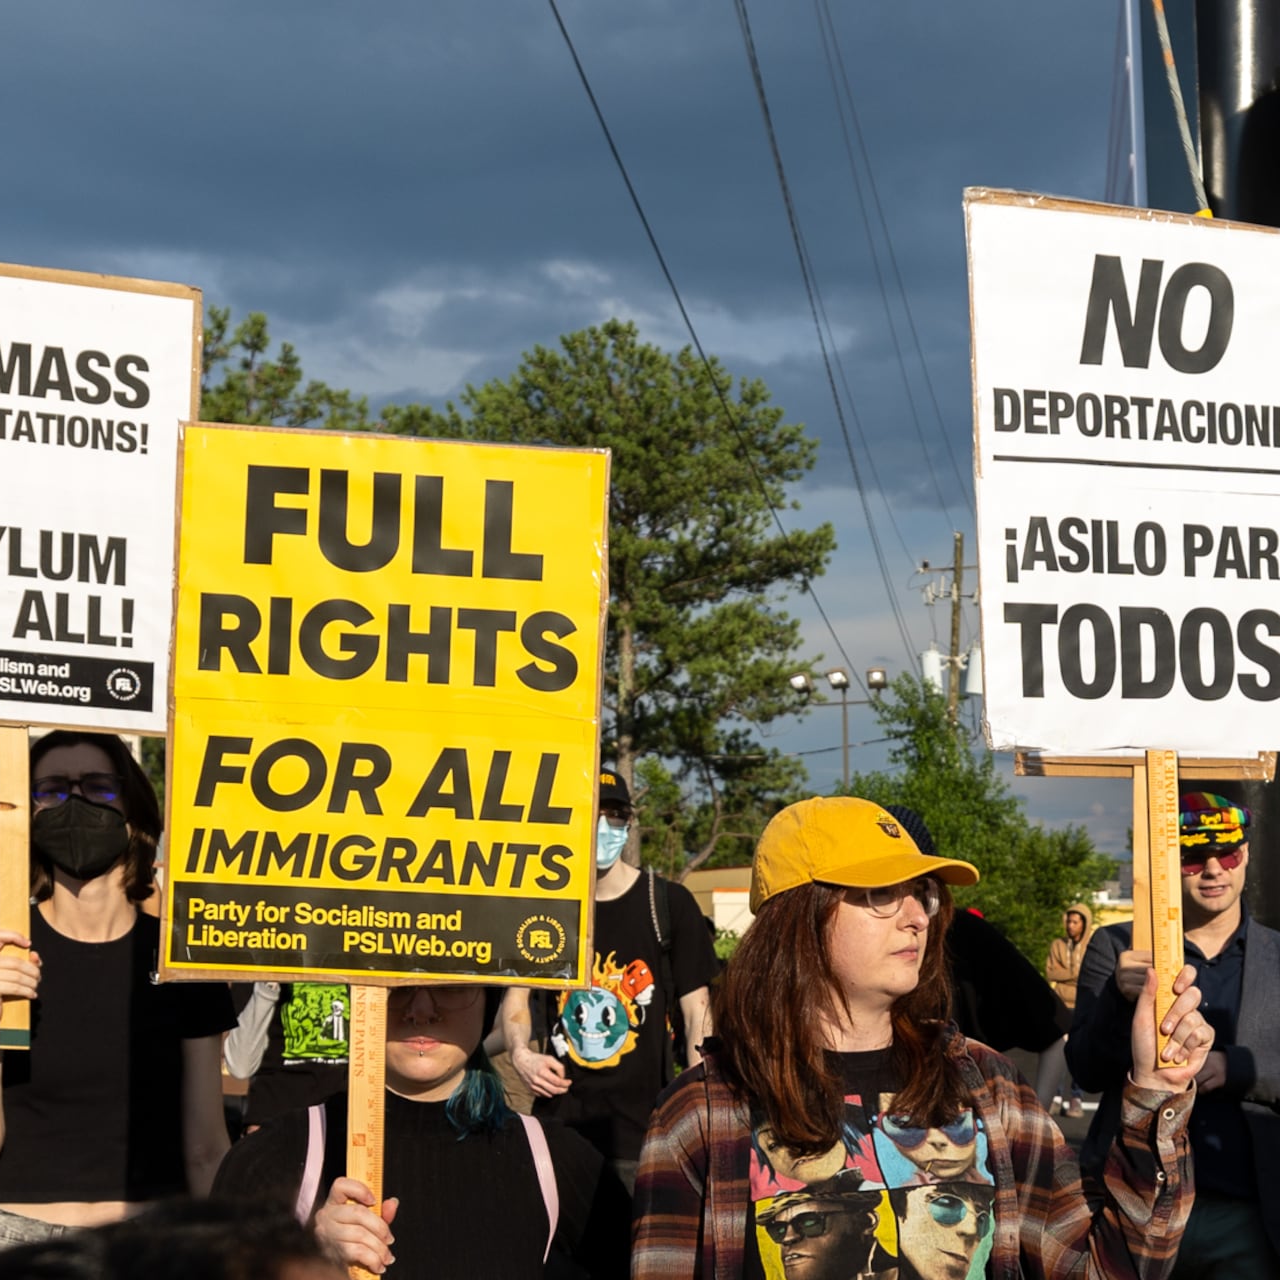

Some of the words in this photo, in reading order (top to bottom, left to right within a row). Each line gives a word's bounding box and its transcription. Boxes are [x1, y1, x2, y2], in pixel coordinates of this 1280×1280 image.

[1080, 254, 1234, 374] NO
[243, 464, 543, 581] FULL
[1005, 516, 1166, 583] ¡ASILO
[13, 589, 134, 648] ALL!
[198, 592, 578, 692] RIGHTS
[37, 661, 70, 679] and
[194, 735, 392, 816] FOR
[406, 747, 573, 825] ALL
[185, 828, 574, 891] IMMIGRANTS
[187, 899, 251, 927] Party
[256, 905, 290, 924] for
[294, 902, 411, 930] Socialism
[416, 910, 462, 932] and
[187, 924, 307, 951] Liberation
[343, 932, 492, 963] PSLWeb.org
